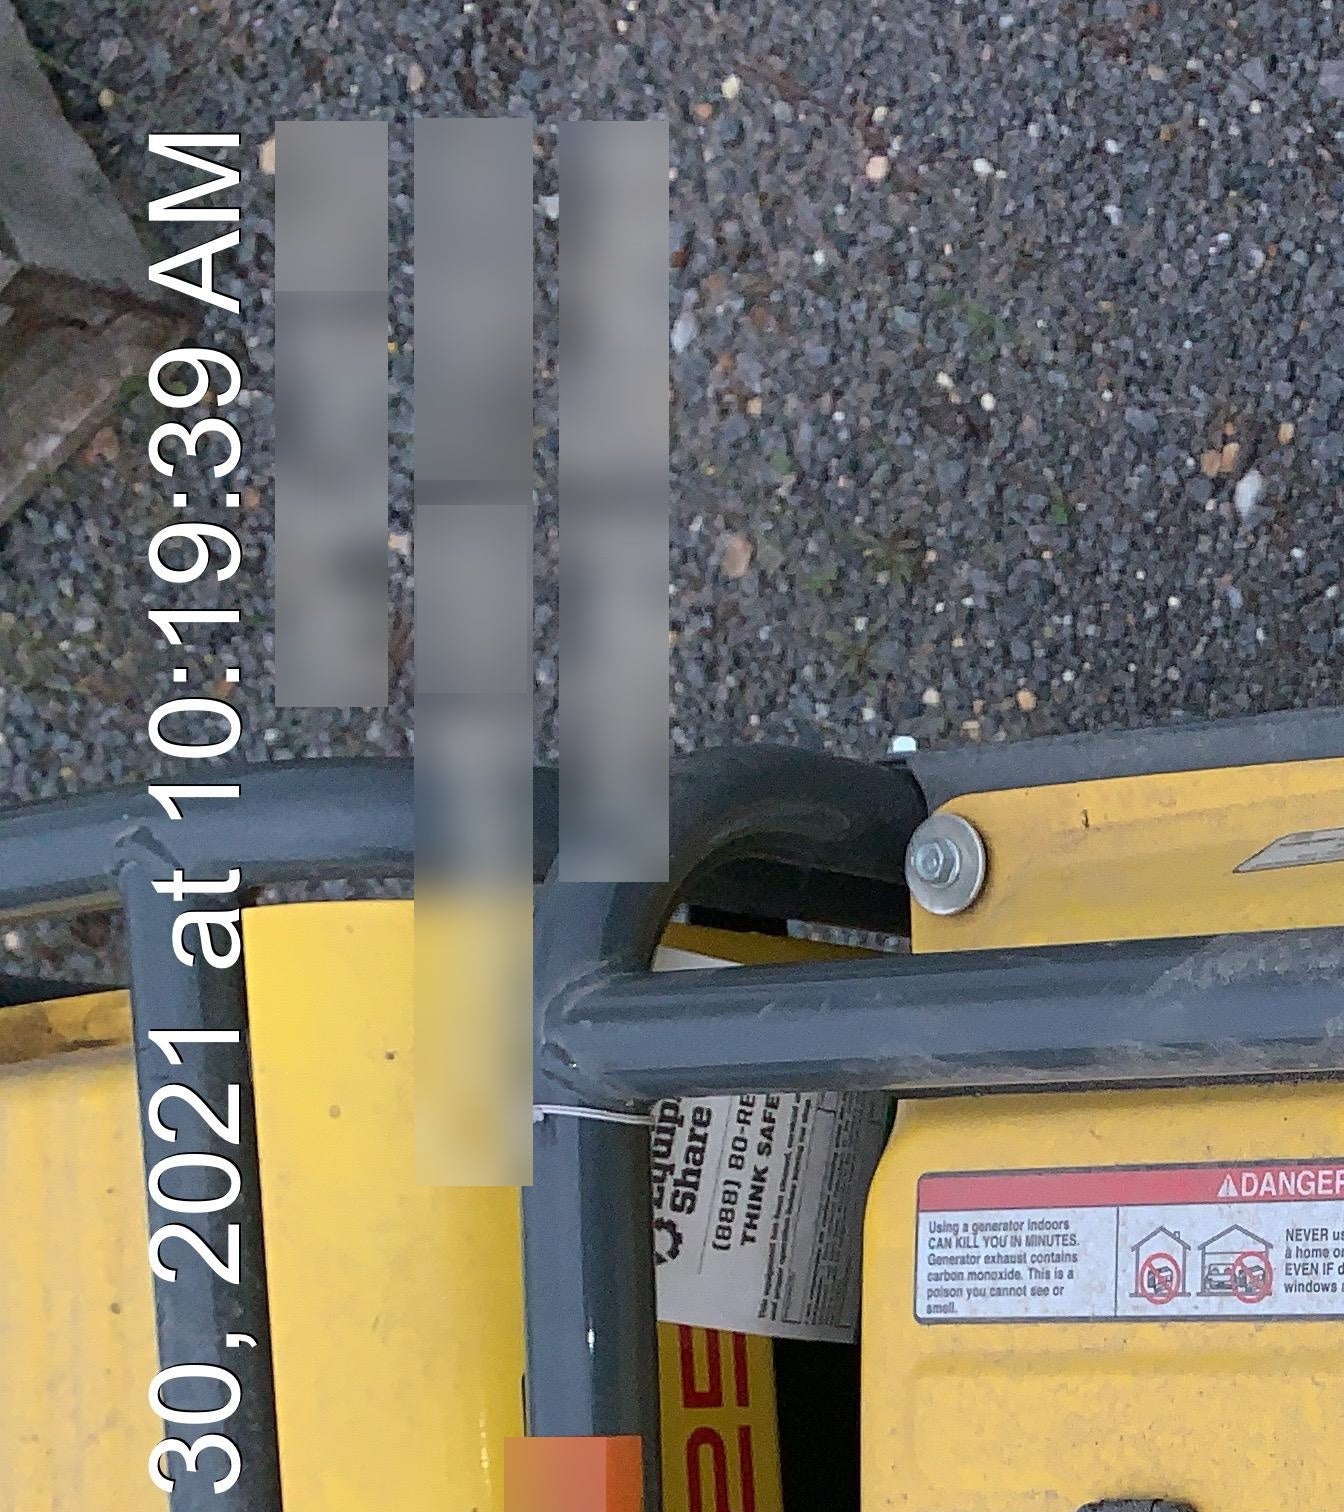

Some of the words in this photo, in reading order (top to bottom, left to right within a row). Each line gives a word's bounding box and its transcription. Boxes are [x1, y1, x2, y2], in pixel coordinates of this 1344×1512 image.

[670, 1106, 712, 1214] Share
[741, 1164, 769, 1246] THINK
[756, 1095, 780, 1157] SAFE
[712, 1180, 742, 1251] (888)
[929, 1219, 959, 1236] Using
[972, 1218, 1024, 1235] generator
[1028, 1217, 1070, 1231] indoors
[1285, 1227, 1328, 1241] NEVER
[928, 1236, 951, 1249] CAN
[955, 1235, 979, 1248] KILL
[983, 1235, 1007, 1248] YOU
[1025, 1233, 1079, 1247] MINUTES.
[928, 1252, 981, 1265] Generator
[984, 1251, 1027, 1264] exhaust
[1030, 1250, 1078, 1263] contains
[1296, 1246, 1329, 1258] home
[1333, 1248, 1344, 1258] or
[927, 1268, 964, 1281] carbon
[1028, 1267, 1050, 1280] This
[1285, 1263, 1318, 1276] EVEN
[1322, 1262, 1334, 1275] IF
[927, 1283, 963, 1300] poison
[966, 1286, 986, 1300] you
[989, 1283, 1027, 1296] cannot
[1030, 1286, 1049, 1295] see
[1284, 1279, 1337, 1293] windows
